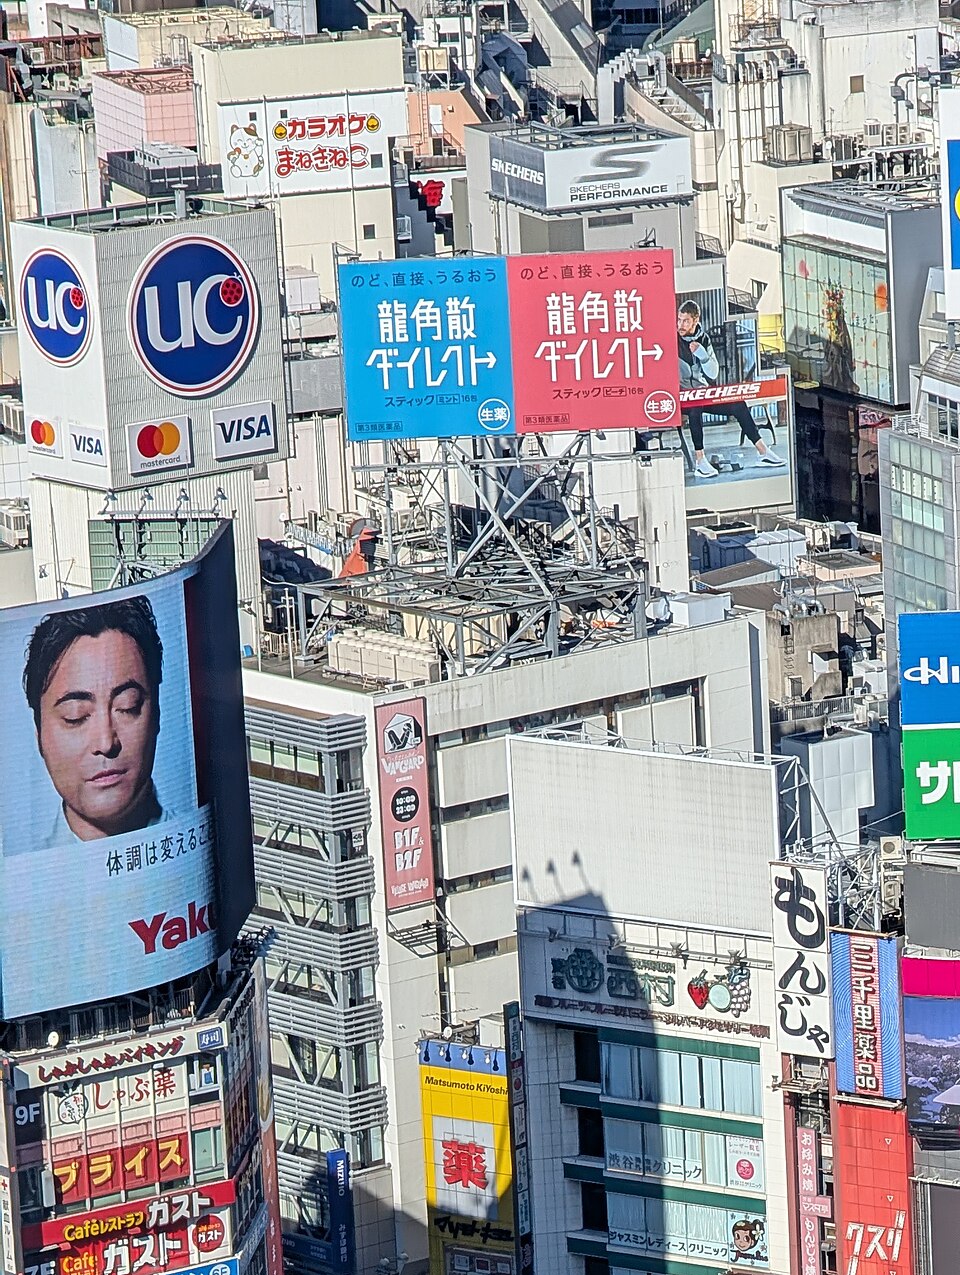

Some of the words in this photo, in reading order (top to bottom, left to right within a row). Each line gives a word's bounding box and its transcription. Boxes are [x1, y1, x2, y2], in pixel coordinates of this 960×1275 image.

[287, 113, 367, 139] カラオケ
[276, 143, 369, 176] まねきねこ
[491, 158, 544, 185] SKECHERS
[569, 182, 620, 194] SKECHERS
[570, 184, 668, 202] PERFORMANCE
[351, 267, 497, 288] のど、直接、うるおう
[520, 261, 664, 282] のど、直接、うるおう
[377, 295, 477, 343] 龍角散
[546, 289, 643, 336] 龍角散
[366, 344, 497, 391] ダイレクト
[534, 337, 664, 382] ダイレクト
[385, 394, 434, 408] スティック
[552, 386, 601, 400] スティック
[481, 406, 508, 423] 生薬
[646, 398, 674, 415] 生薬
[216, 414, 271, 443] VISA
[71, 432, 103, 456] VISA
[140, 455, 181, 469] mastercard
[393, 826, 420, 850] B1F
[395, 848, 422, 872] B2F
[775, 866, 830, 1054] もんじゃ
[850, 943, 878, 1091] 三千里薬品
[201, 1032, 220, 1045] 寿司
[94, 1067, 177, 1110] しゃぶ葉
[425, 1075, 475, 1092] Matsumoto
[14, 1102, 41, 1126] 9F
[442, 1139, 489, 1190] 薬
[801, 1132, 814, 1193] お好み焼
[147, 1192, 211, 1229] ガスト
[198, 1231, 222, 1243] ガスト
